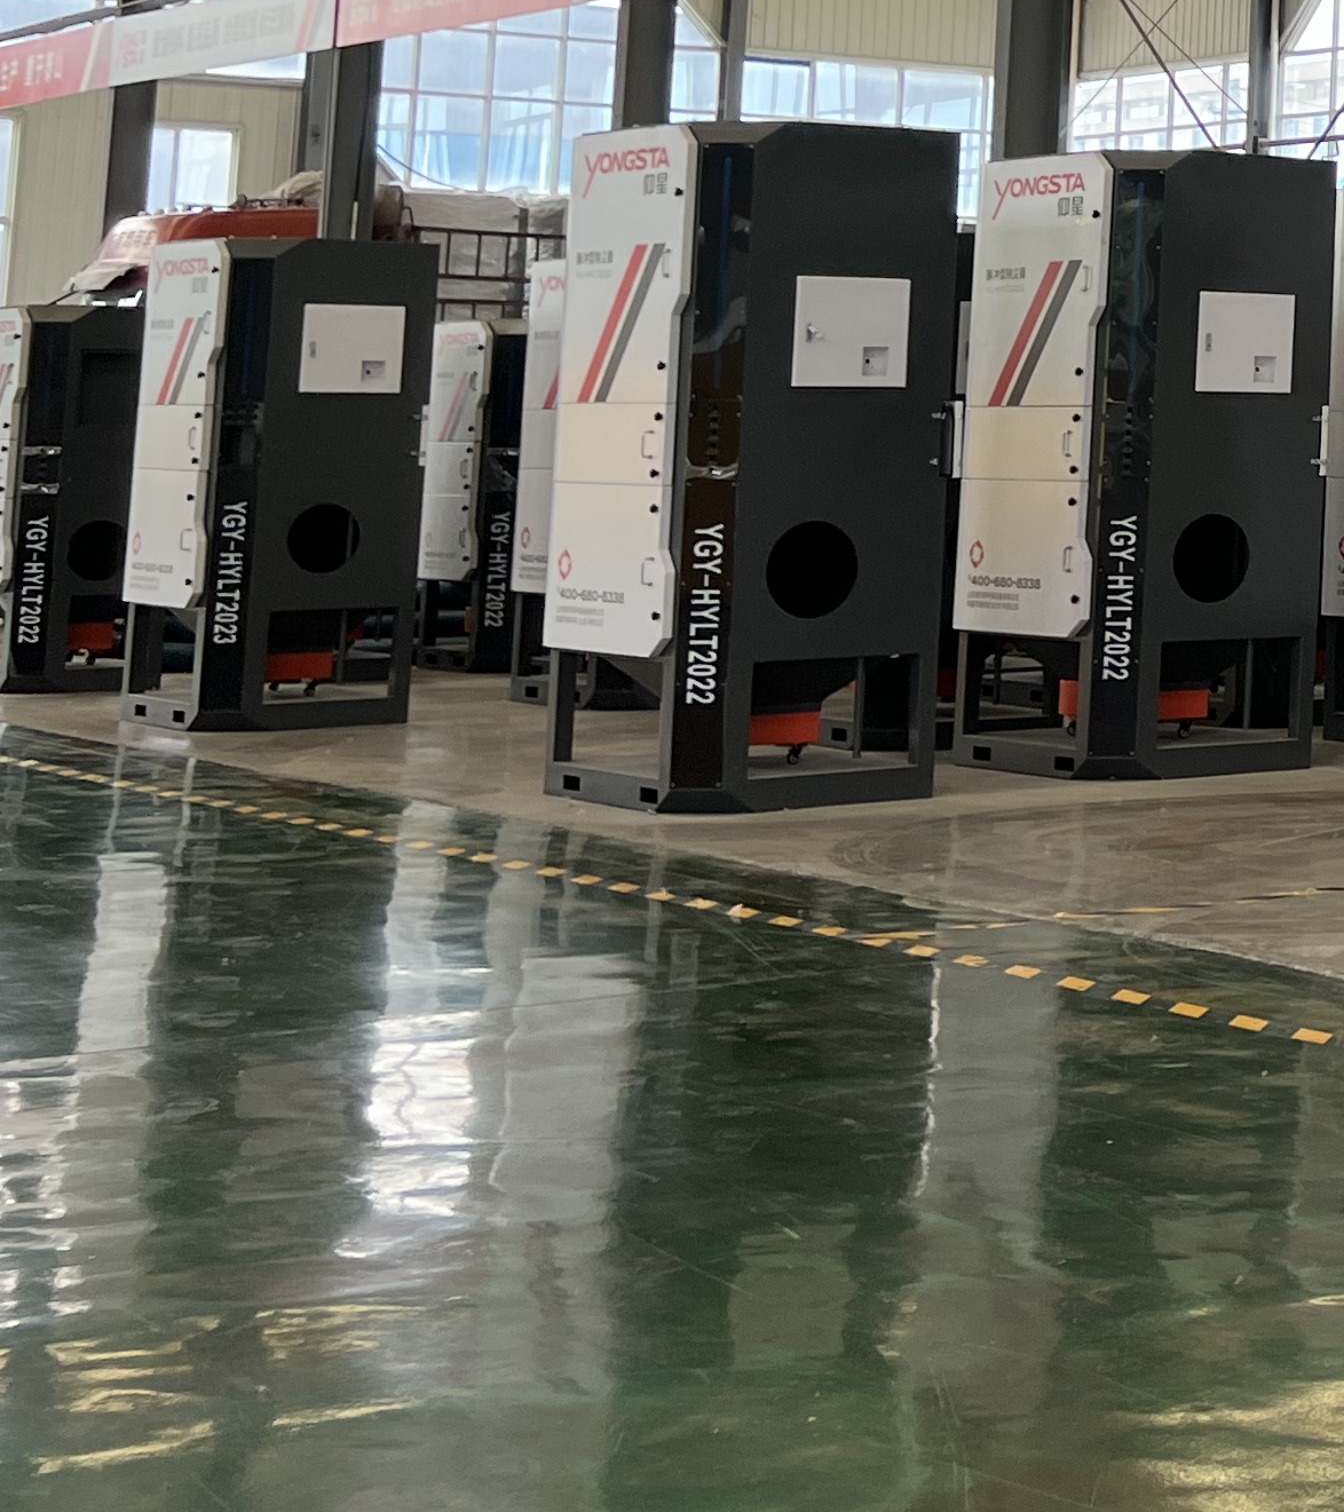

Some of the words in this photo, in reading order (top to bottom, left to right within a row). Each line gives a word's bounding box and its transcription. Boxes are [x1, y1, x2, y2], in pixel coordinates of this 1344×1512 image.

[582, 147, 670, 199] YONGSTA
[992, 173, 1085, 220] YONGSTA
[18, 515, 49, 644] YGY-HYLT2022
[213, 501, 248, 644] YGY-HYLT2023
[484, 512, 511, 627] YGY-HYLT2022
[687, 523, 725, 704] YGY-HYLT2022
[972, 575, 1041, 589] 400-680-8338
[1102, 515, 1137, 680] YGY-HYLT2022
